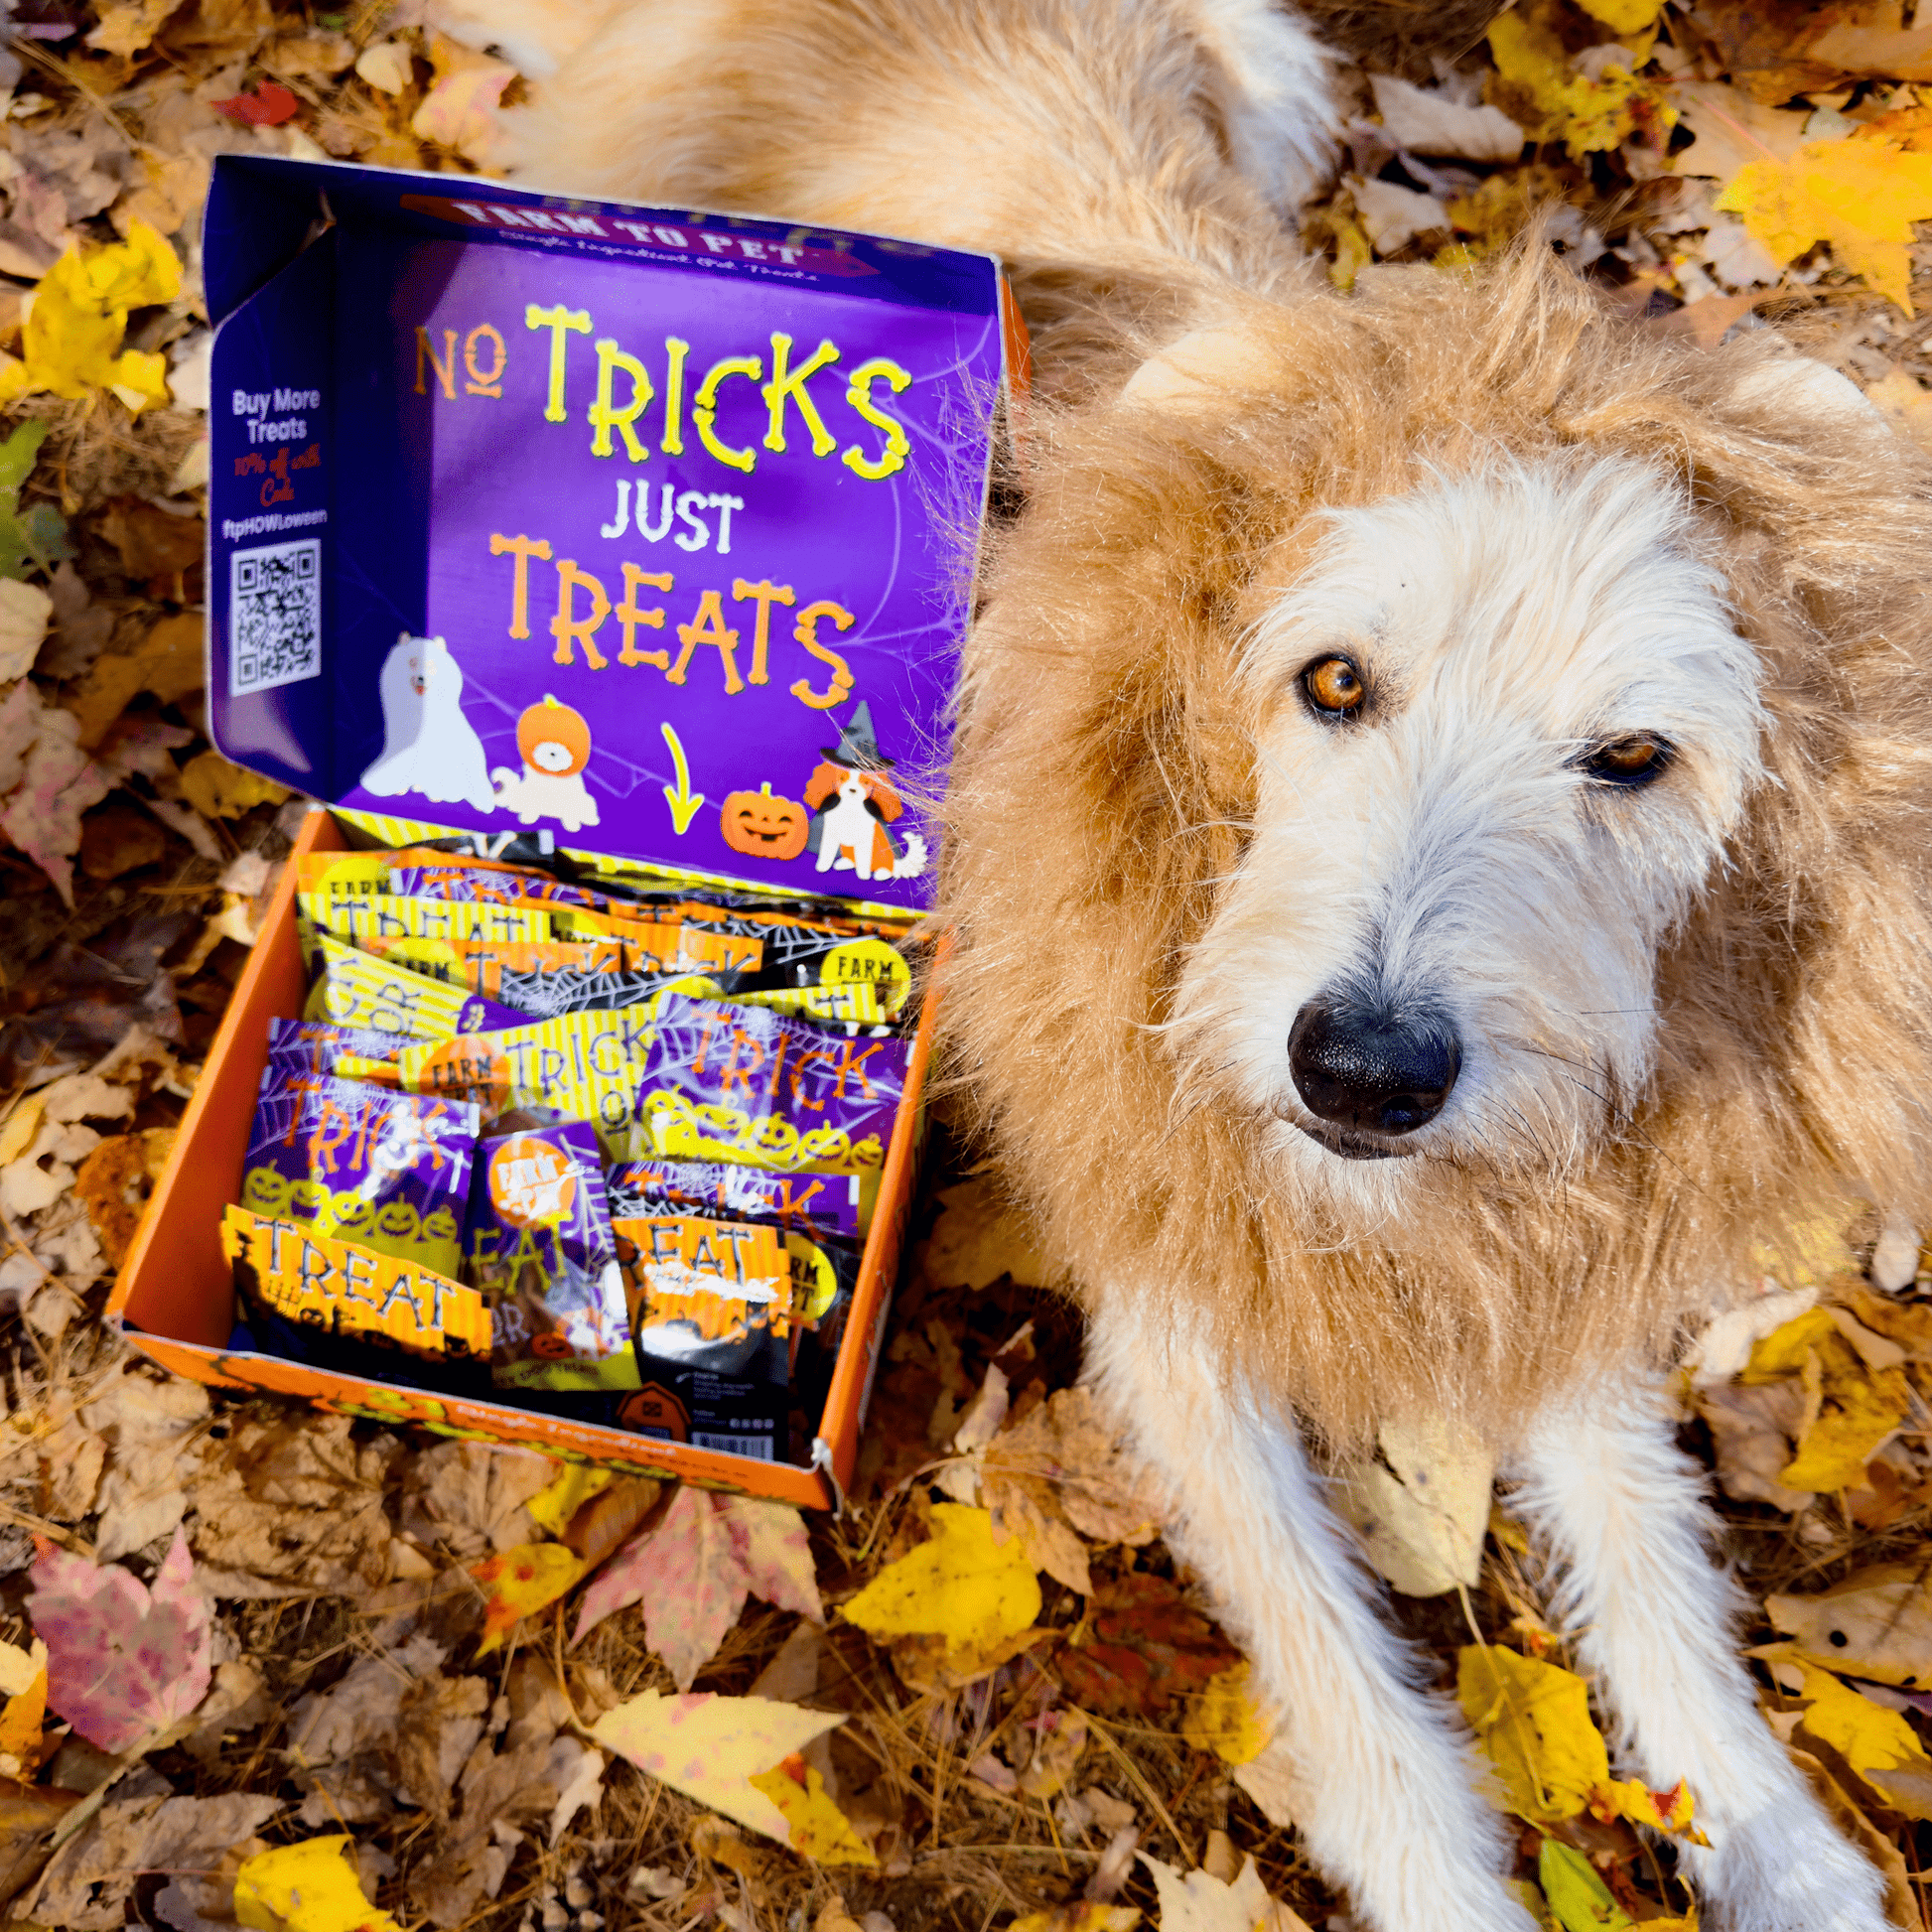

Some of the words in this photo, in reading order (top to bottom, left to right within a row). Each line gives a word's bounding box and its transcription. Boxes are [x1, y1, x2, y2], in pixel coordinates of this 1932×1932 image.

[451, 202, 610, 238] FARM
[613, 219, 689, 248] TO
[699, 231, 806, 265] PET
[232, 390, 271, 421] Buy
[273, 386, 322, 412] More
[246, 416, 308, 445] Treats
[413, 323, 506, 399] NO
[524, 303, 912, 482] TRICKS
[600, 478, 745, 554] JUST
[488, 531, 857, 710] TREATS
[836, 954, 895, 983] FARM
[432, 1054, 492, 1090] FARM
[504, 1019, 652, 1099] TRICK
[691, 1005, 884, 1112] TRICK
[253, 1216, 457, 1331] TREAT
